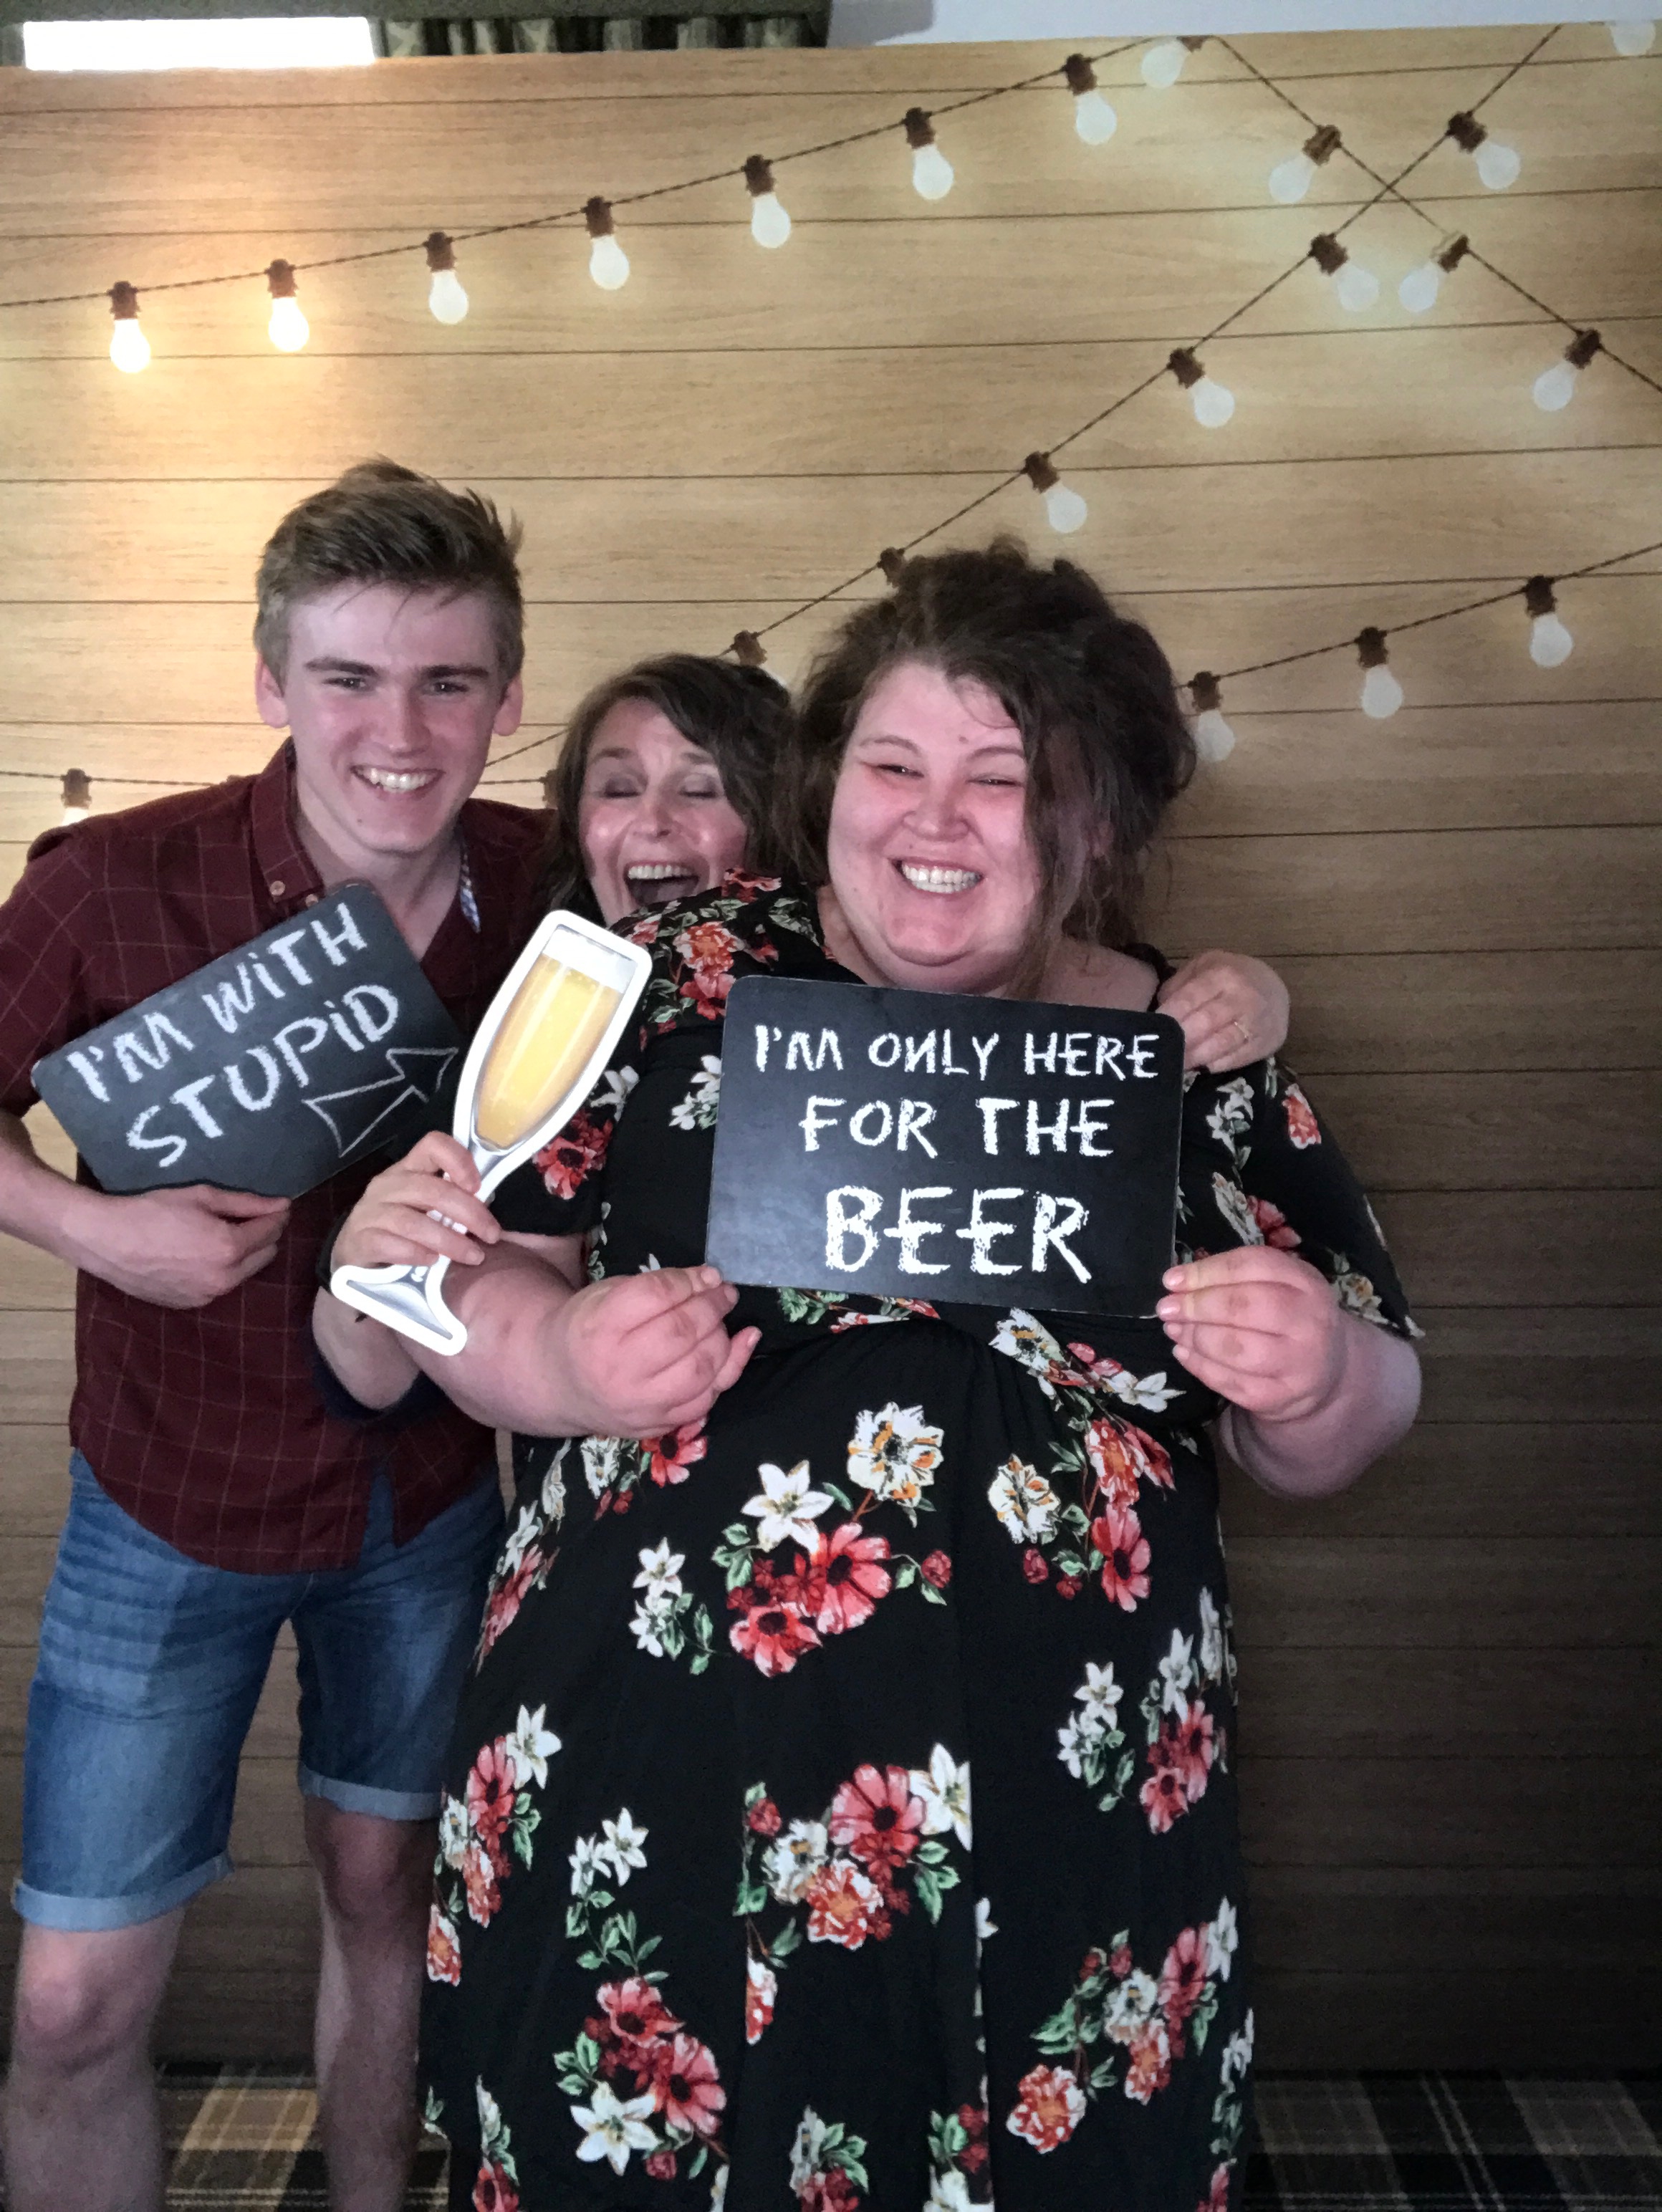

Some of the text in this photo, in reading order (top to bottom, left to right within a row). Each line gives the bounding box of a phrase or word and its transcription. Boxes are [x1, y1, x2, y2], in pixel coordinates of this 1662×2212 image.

[67, 1011, 195, 1103] I'M
[756, 1025, 1159, 1080] I'M ONLY HERE
[798, 1095, 1115, 1158] FOR THE
[825, 1185, 1091, 1283] BEER
